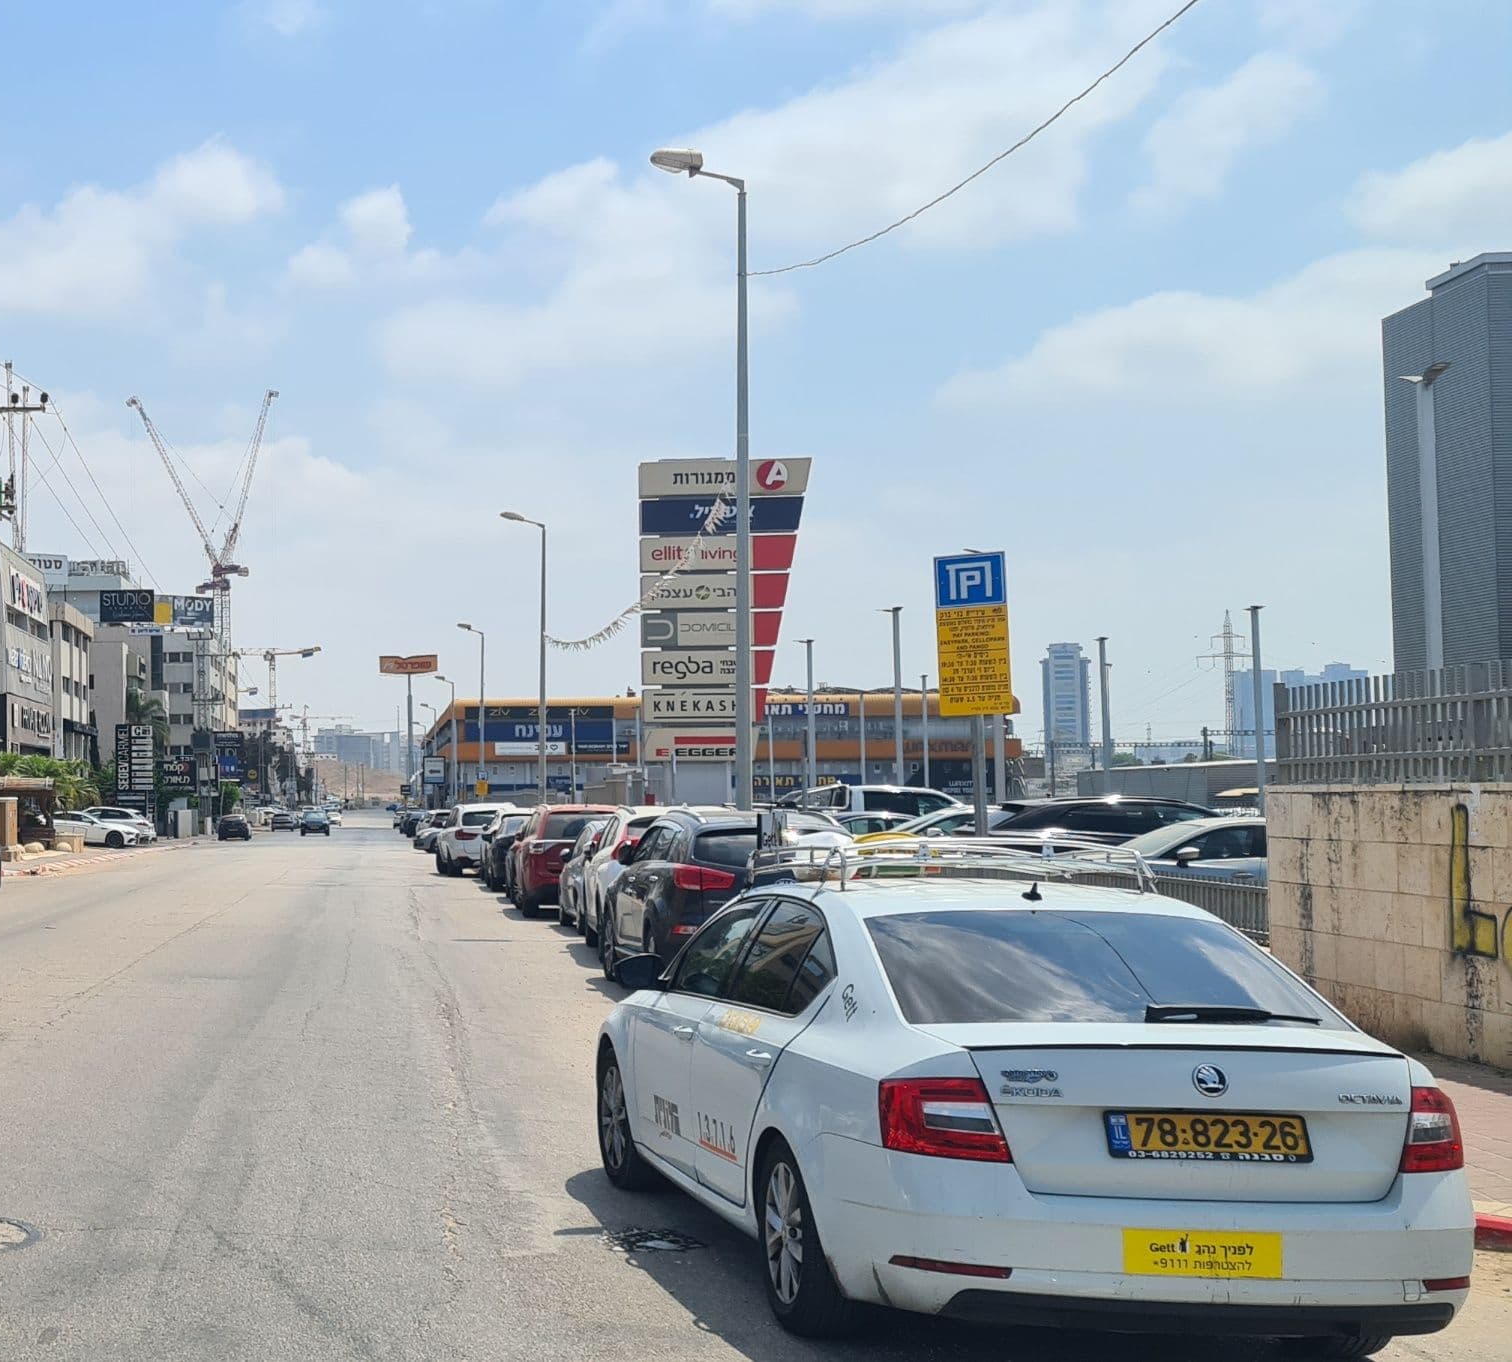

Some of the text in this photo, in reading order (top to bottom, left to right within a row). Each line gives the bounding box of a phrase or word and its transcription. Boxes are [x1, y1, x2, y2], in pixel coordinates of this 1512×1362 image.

[651, 545, 695, 561] ellit
[959, 570, 981, 600] P
[102, 592, 151, 607] STUDIO
[174, 598, 212, 612] MODY
[964, 630, 990, 638] PARKING
[652, 655, 714, 680] regba
[764, 703, 793, 716] תאו
[753, 775, 794, 787] תארה
[1149, 1242, 1255, 1259] לפניך נהג Gett
